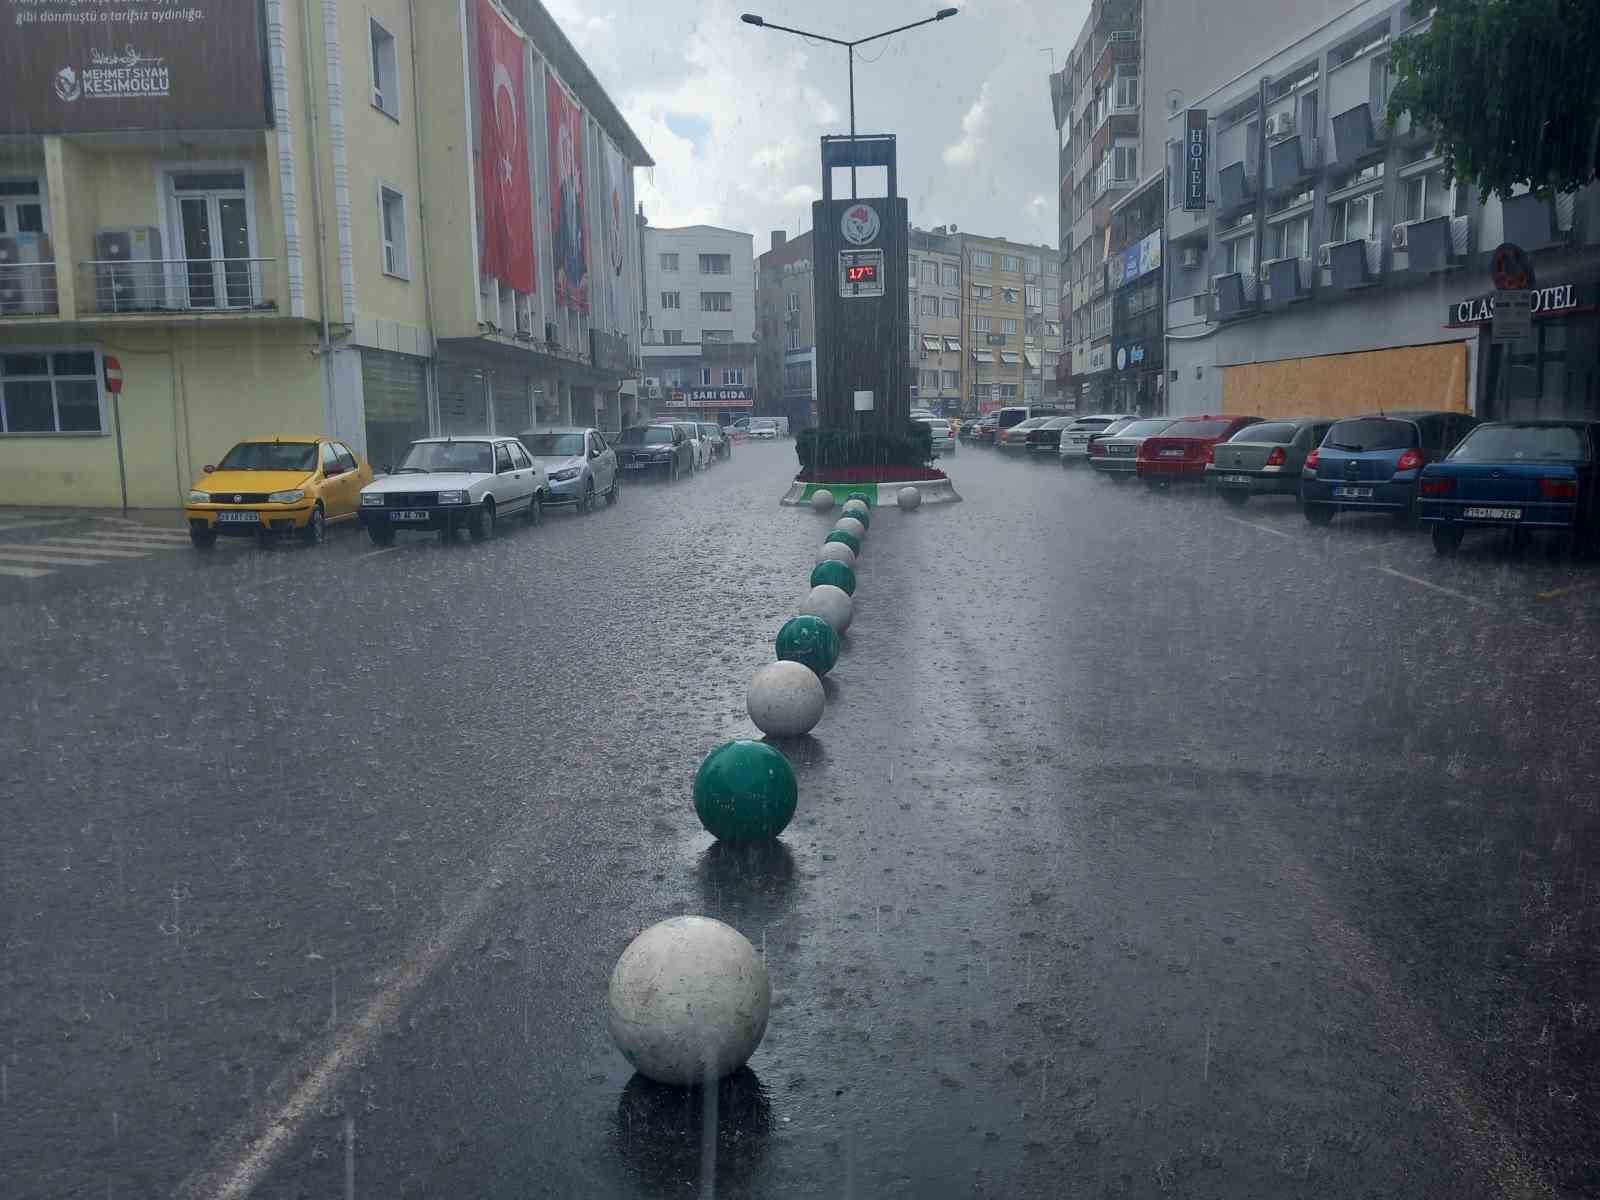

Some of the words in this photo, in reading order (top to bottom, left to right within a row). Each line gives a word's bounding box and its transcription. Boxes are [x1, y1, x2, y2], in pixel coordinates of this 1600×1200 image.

[82, 69, 131, 80] MEHMET
[1191, 129, 1202, 198] HOTEL
[1457, 296, 1495, 323] CLAS
[1529, 284, 1577, 313] OTEL
